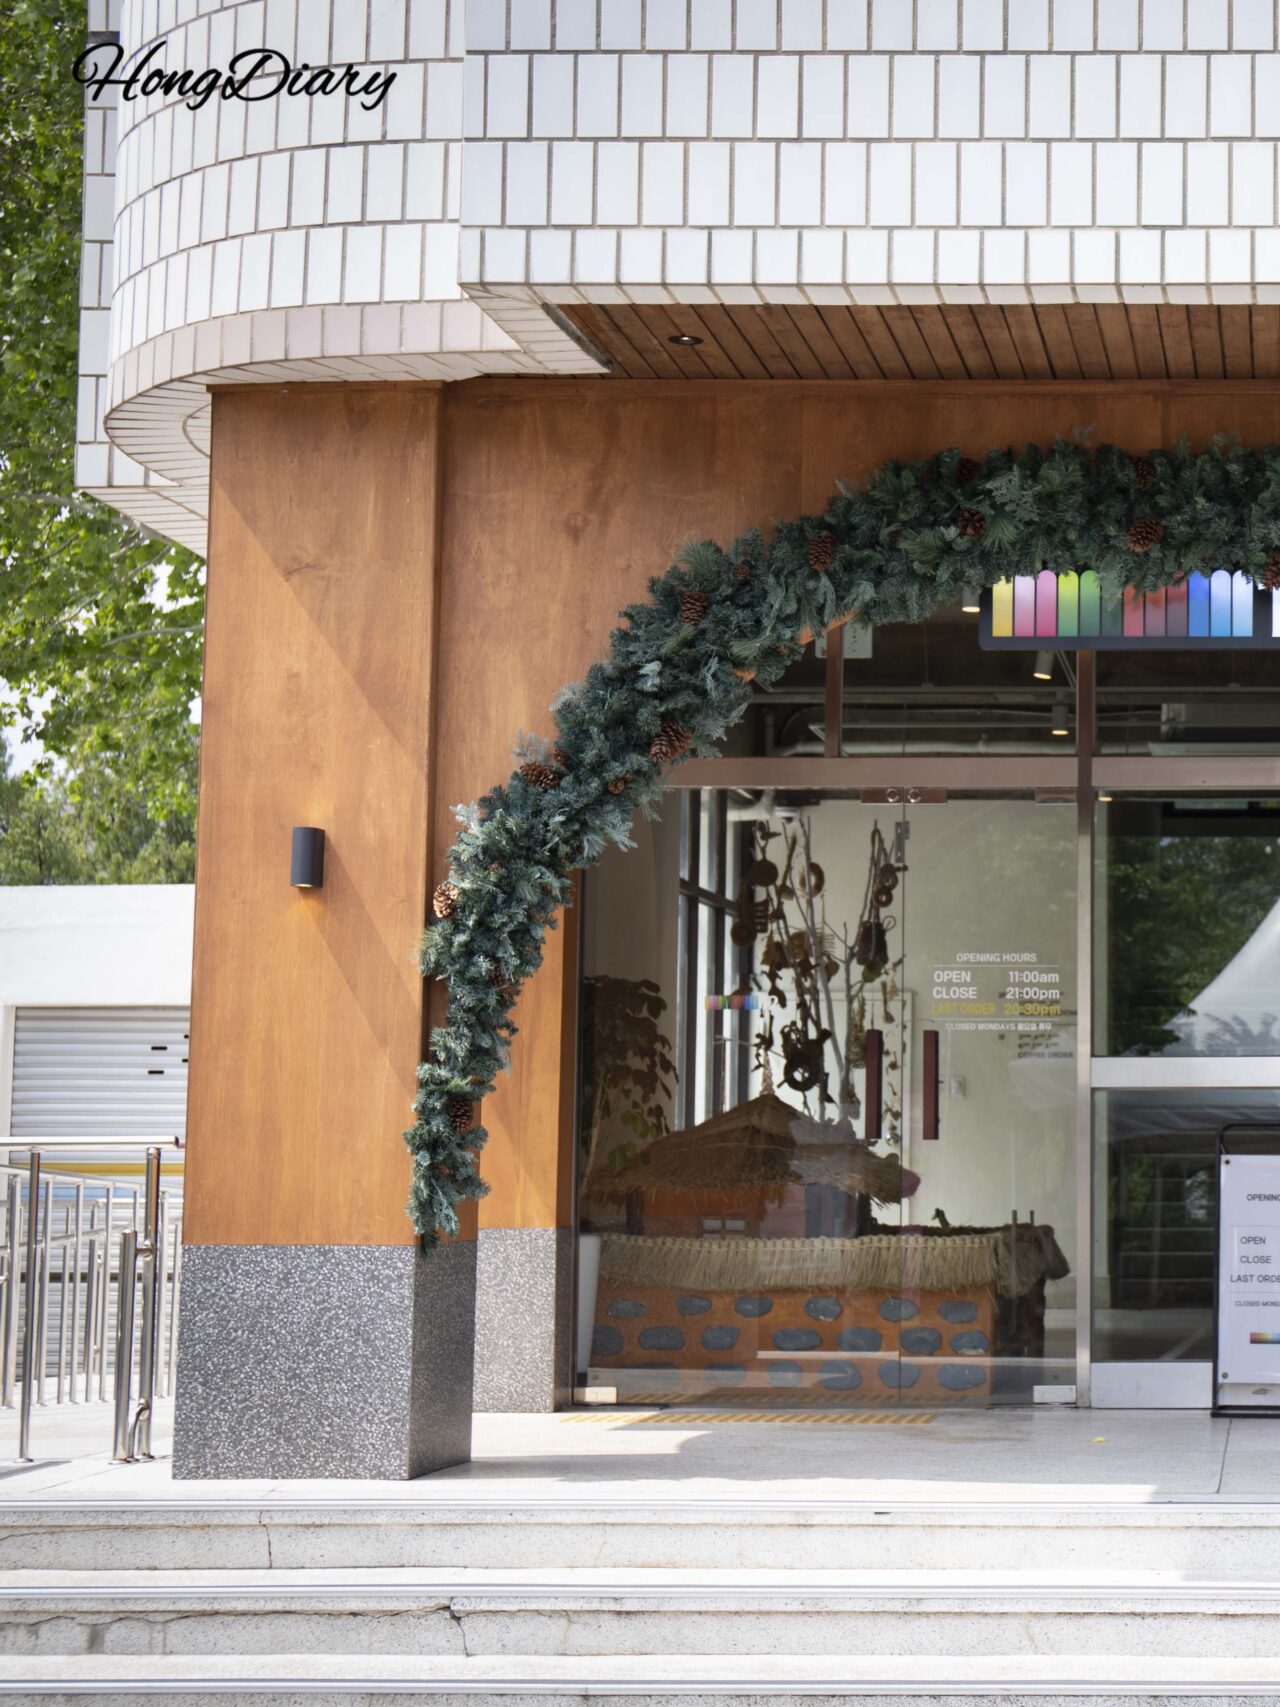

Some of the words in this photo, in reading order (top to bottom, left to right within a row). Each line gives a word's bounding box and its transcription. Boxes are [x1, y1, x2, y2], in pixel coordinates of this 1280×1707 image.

[956, 953, 1000, 962] OPENING
[1002, 953, 1037, 962] HOURS
[934, 971, 971, 983] OPEN
[1009, 971, 1060, 983] 11:00am
[932, 987, 977, 999] CLOSE
[1006, 987, 1060, 1001] 21:00pm
[931, 1003, 956, 1015] LAST
[960, 1003, 996, 1015] ORDER
[1003, 1003, 1061, 1016] 20:30pm
[945, 1023, 976, 1031] CLOSED
[977, 1023, 1016, 1031] MONDAYS
[1240, 1236, 1266, 1245] OPEN
[1240, 1256, 1272, 1264] CLOSE
[1230, 1275, 1254, 1283] LAST
